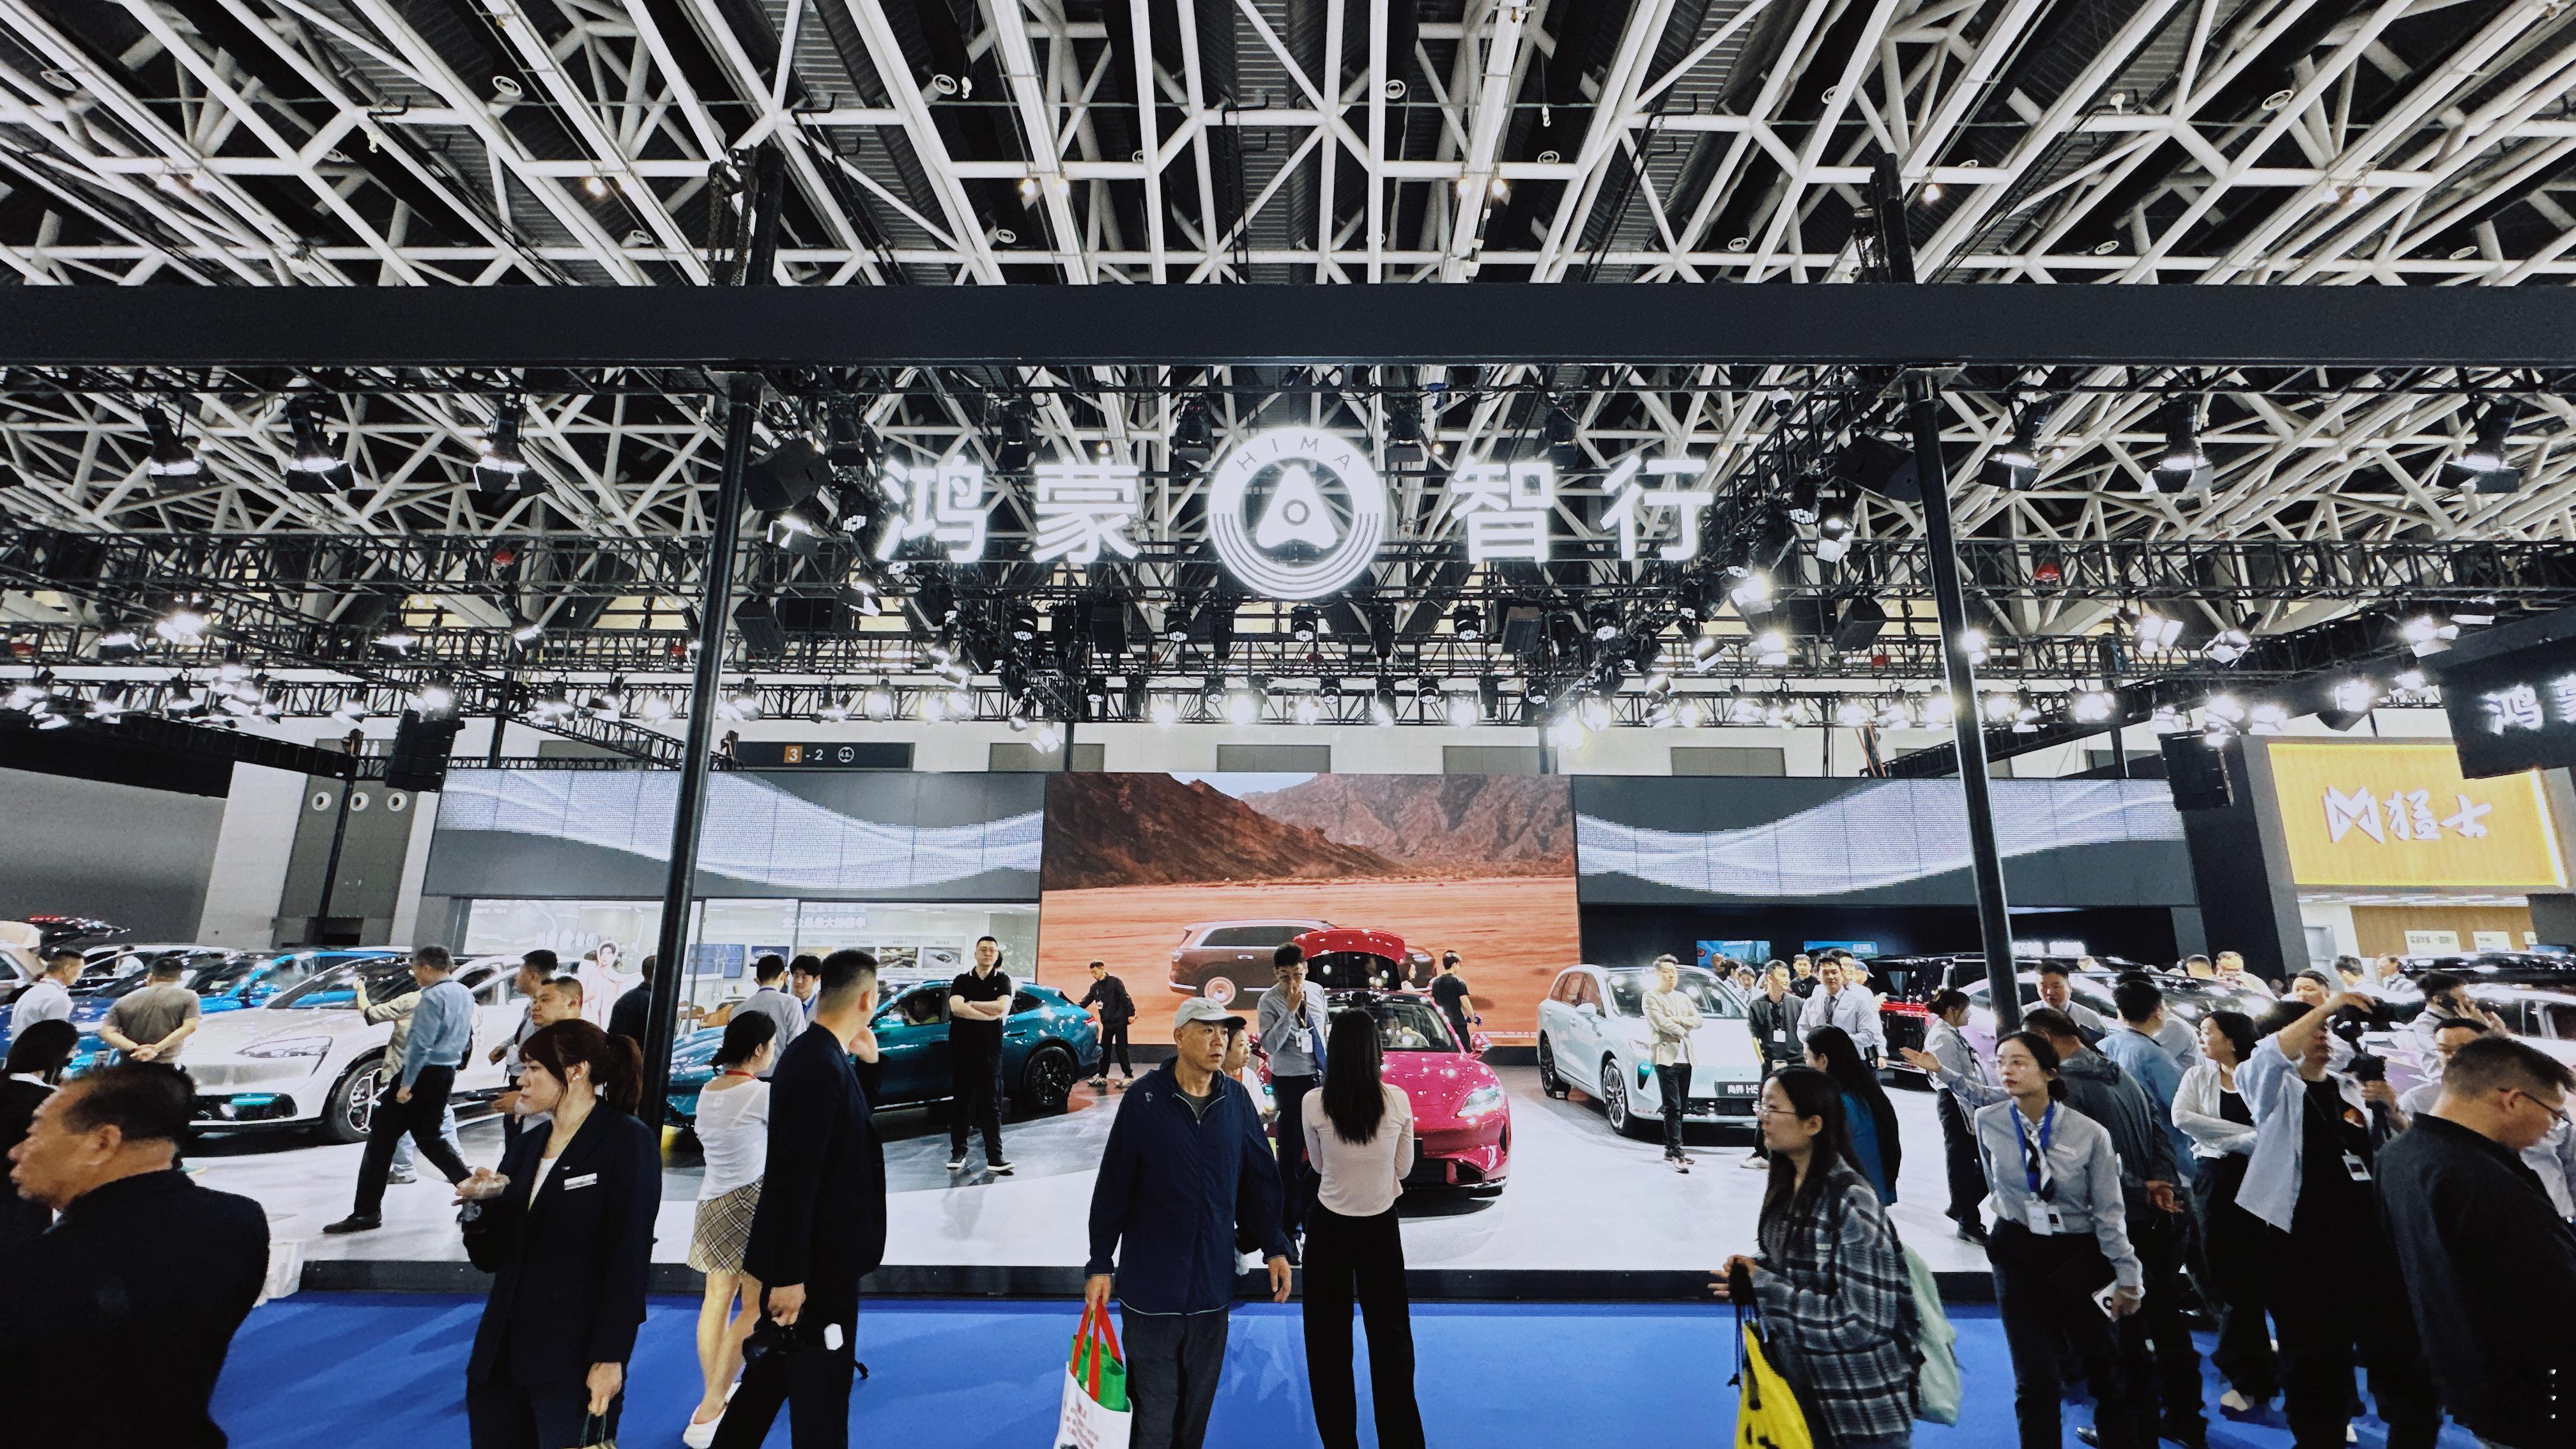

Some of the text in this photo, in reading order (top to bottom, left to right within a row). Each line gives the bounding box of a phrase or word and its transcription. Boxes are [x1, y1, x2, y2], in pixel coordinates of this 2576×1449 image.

[1236, 435, 1351, 471] HIMA
[875, 454, 1714, 564] 鸿蒙 智行
[2382, 790, 2492, 841] 猛士
